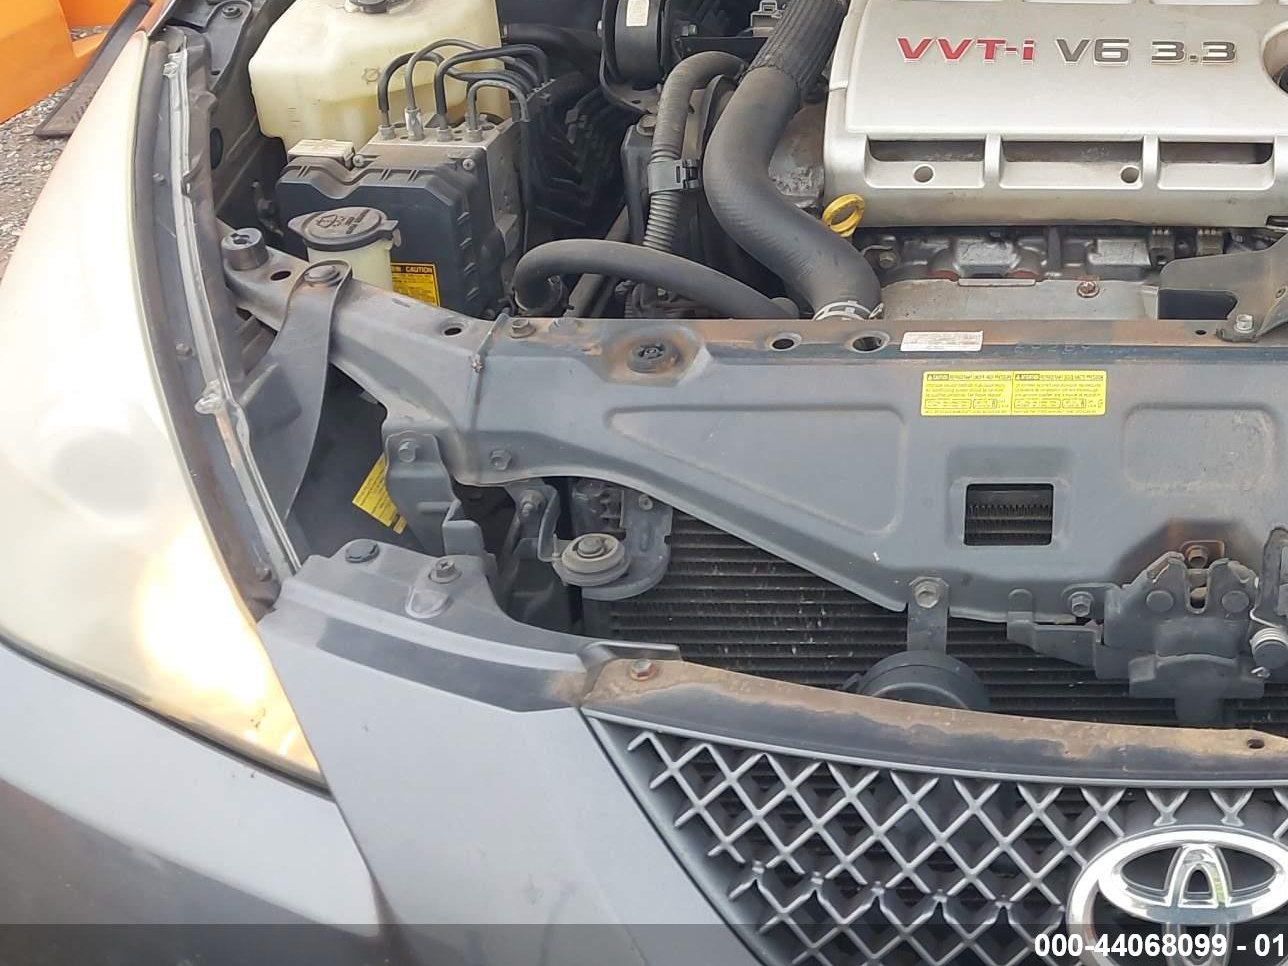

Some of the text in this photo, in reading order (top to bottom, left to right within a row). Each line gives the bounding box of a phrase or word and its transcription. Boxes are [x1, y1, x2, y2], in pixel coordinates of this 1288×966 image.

[896, 37, 1237, 66] VVT-i V6 3.3
